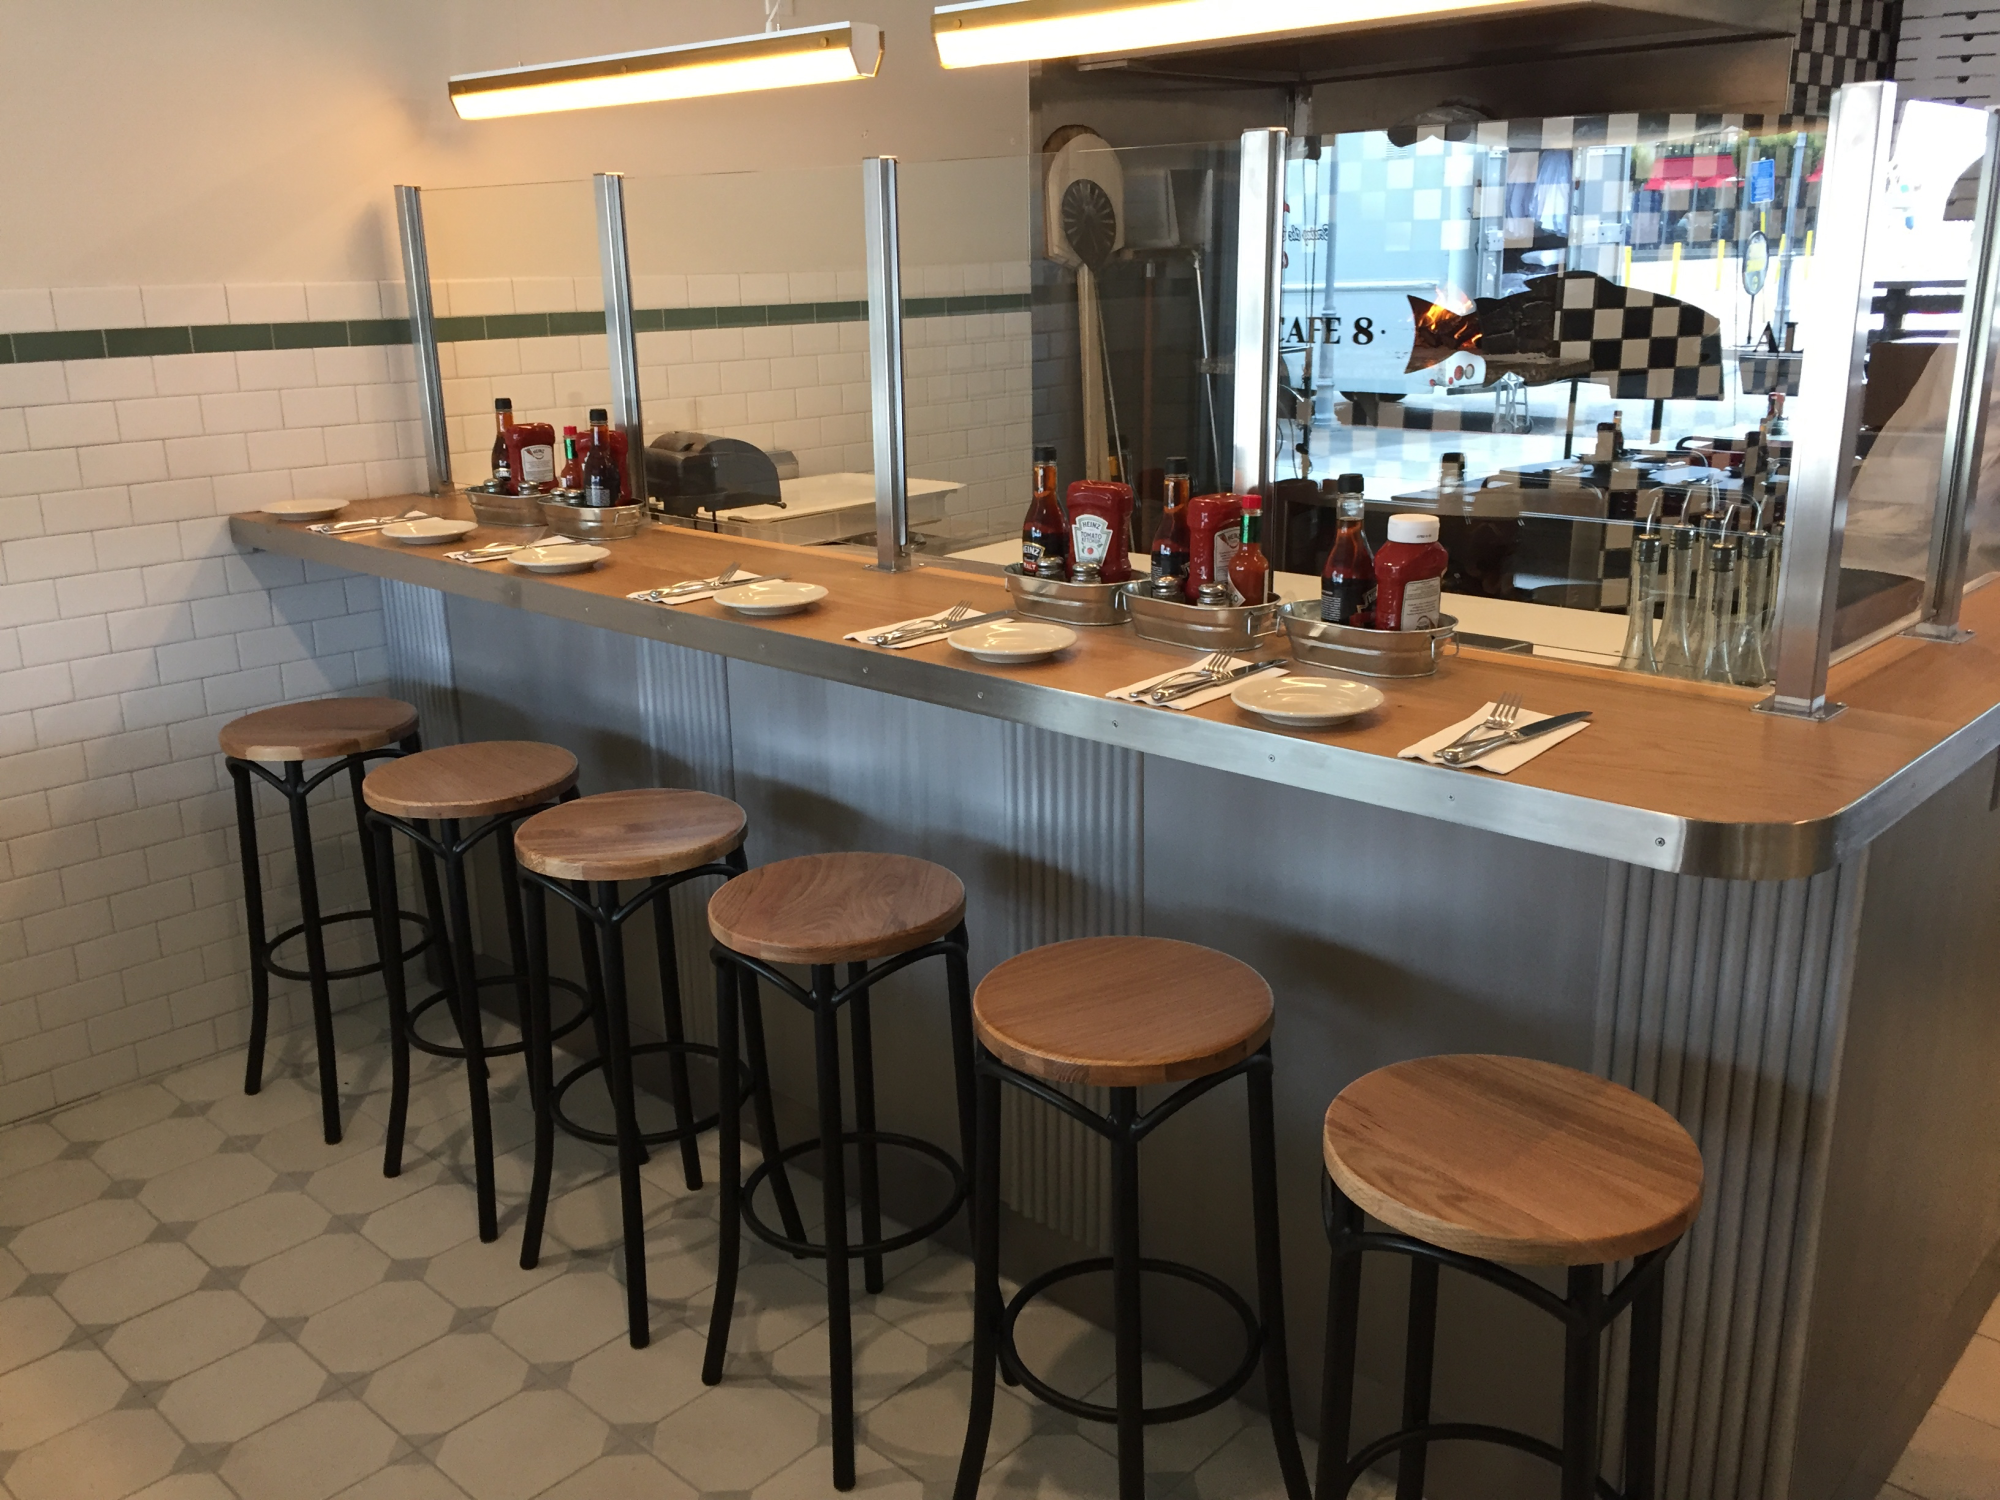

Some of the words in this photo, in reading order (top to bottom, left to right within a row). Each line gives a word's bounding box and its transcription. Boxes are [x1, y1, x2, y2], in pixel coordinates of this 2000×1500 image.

[1280, 316, 1341, 344] AFE
[1352, 317, 1374, 345] 8
[1082, 521, 1101, 529] HEINZ
[1081, 531, 1102, 540] TOMATO
[1023, 545, 1039, 556] EINZ
